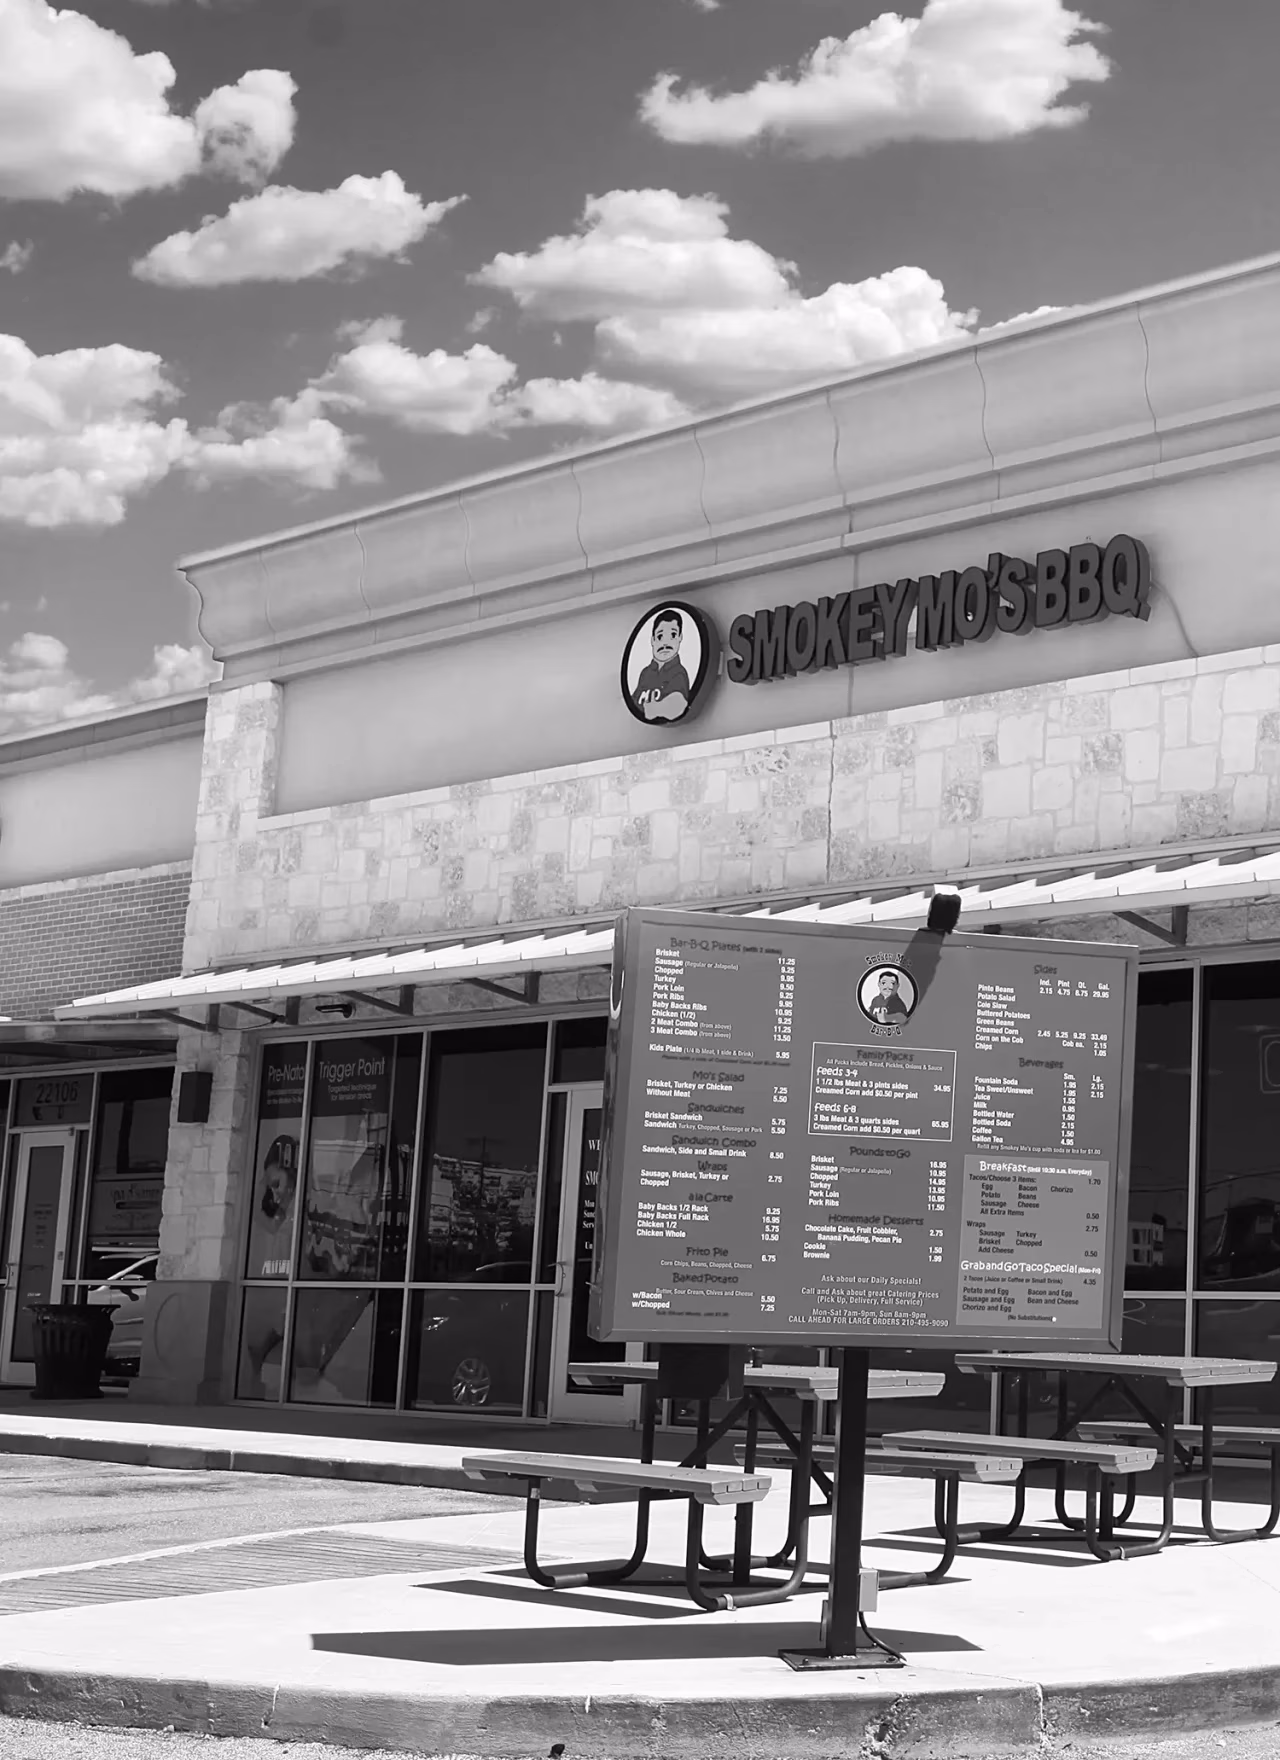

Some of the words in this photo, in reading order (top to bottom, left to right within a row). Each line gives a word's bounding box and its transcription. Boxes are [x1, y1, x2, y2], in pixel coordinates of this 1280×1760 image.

[727, 580, 911, 685] SMOKEY
[915, 552, 1034, 652] MO'S
[1035, 534, 1151, 628] BBQ
[655, 948, 680, 958] Brisket
[778, 957, 796, 966] 11.25
[654, 966, 684, 976] Chopped
[654, 975, 677, 984] Turkey
[652, 992, 669, 1000] Pork
[669, 993, 685, 1001] Ribs
[652, 1001, 670, 1010] Baby
[670, 1002, 691, 1010] Backs
[774, 1026, 792, 1034] 11.25
[976, 1026, 1003, 1034] Creamed
[773, 1034, 791, 1042] 13.50
[976, 1034, 990, 1042] Corn
[1012, 1036, 1024, 1044] Cob
[975, 1043, 993, 1051] Chips
[268, 1064, 306, 1082] Pre-Nata
[319, 1060, 356, 1082] Trigger
[357, 1056, 385, 1076] Point
[975, 1077, 1002, 1085] Fountain
[35, 1081, 79, 1105] 22106
[647, 1089, 672, 1097] Without
[644, 1111, 669, 1120] Brisket
[670, 1112, 703, 1121] Sandwich
[644, 1120, 677, 1129] Sandwich
[771, 1127, 786, 1135] 5.50
[642, 1145, 677, 1154] Sandwich,
[708, 1148, 727, 1156] Small
[811, 1155, 835, 1163] Brisket
[810, 1164, 838, 1173] Sausage
[979, 1161, 1027, 1173] Breakfast
[810, 1173, 838, 1181] Chopped
[640, 1179, 670, 1187] Chopped
[809, 1182, 831, 1190] Turkey
[638, 1203, 656, 1211] Baby
[656, 1203, 678, 1211] Backs
[637, 1212, 655, 1220] Baby
[656, 1212, 677, 1220] Backs
[637, 1220, 664, 1228] Chicken
[636, 1229, 664, 1237] Chicken
[665, 1230, 686, 1238] Whole
[803, 1251, 830, 1259] Brownie
[871, 1277, 888, 1285] Daily
[890, 1277, 922, 1285] Specials!
[801, 1287, 815, 1295] Call
[831, 1288, 845, 1296] Ask
[887, 1290, 916, 1298] Catering
[632, 1301, 670, 1309] w/Chopped
[817, 1296, 835, 1304] (Pick
[837, 1297, 848, 1305] Up,
[850, 1297, 879, 1306] Delivery,
[895, 1298, 923, 1307] Service)
[902, 1319, 949, 1327] 210-495-9090
